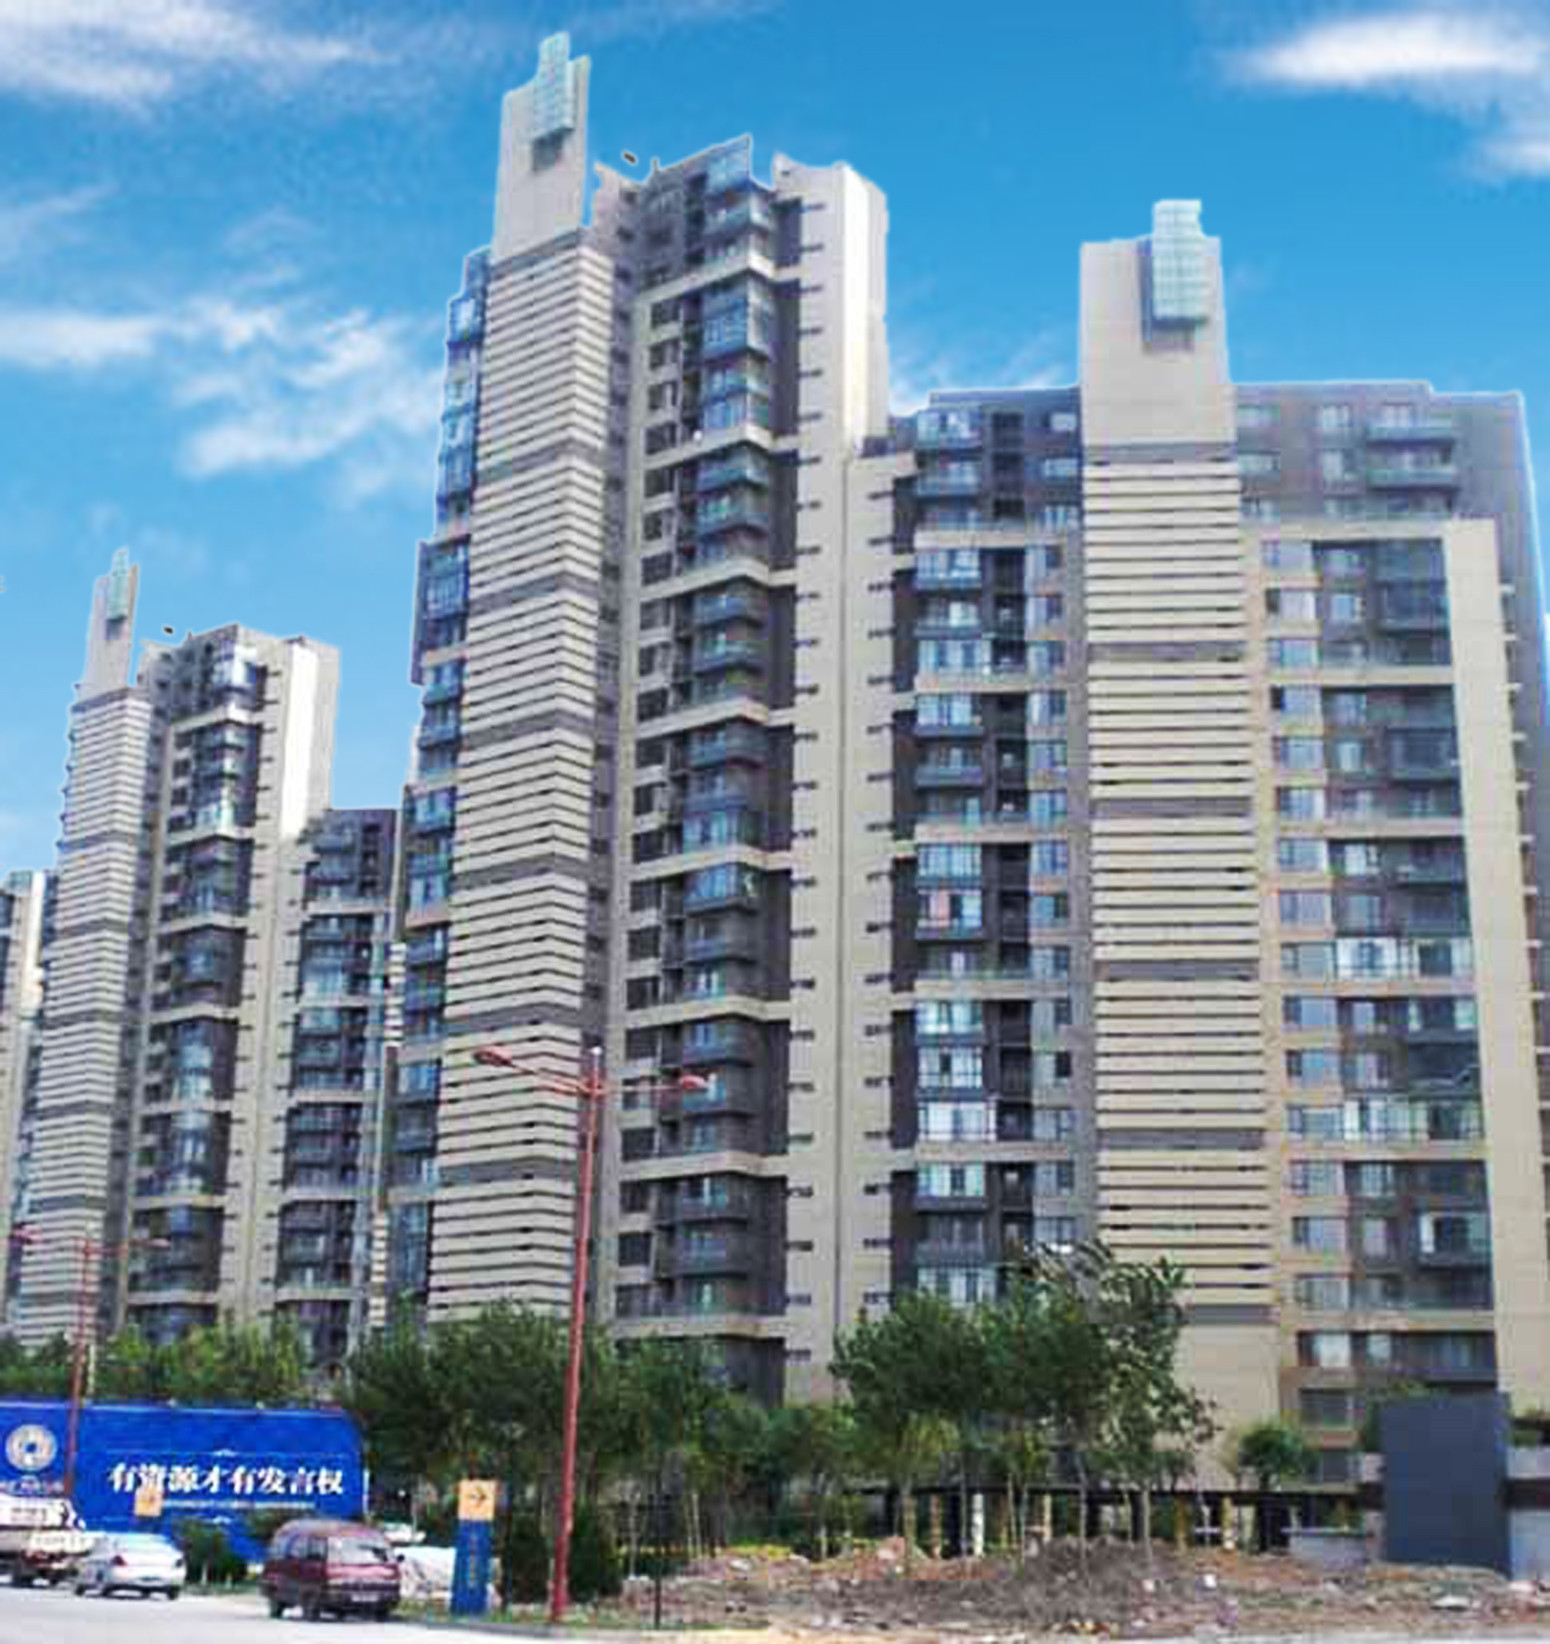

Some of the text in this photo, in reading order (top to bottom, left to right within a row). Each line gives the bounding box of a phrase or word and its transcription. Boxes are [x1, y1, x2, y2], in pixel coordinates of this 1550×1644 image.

[108, 1463, 344, 1494] 有资源才有发言权
